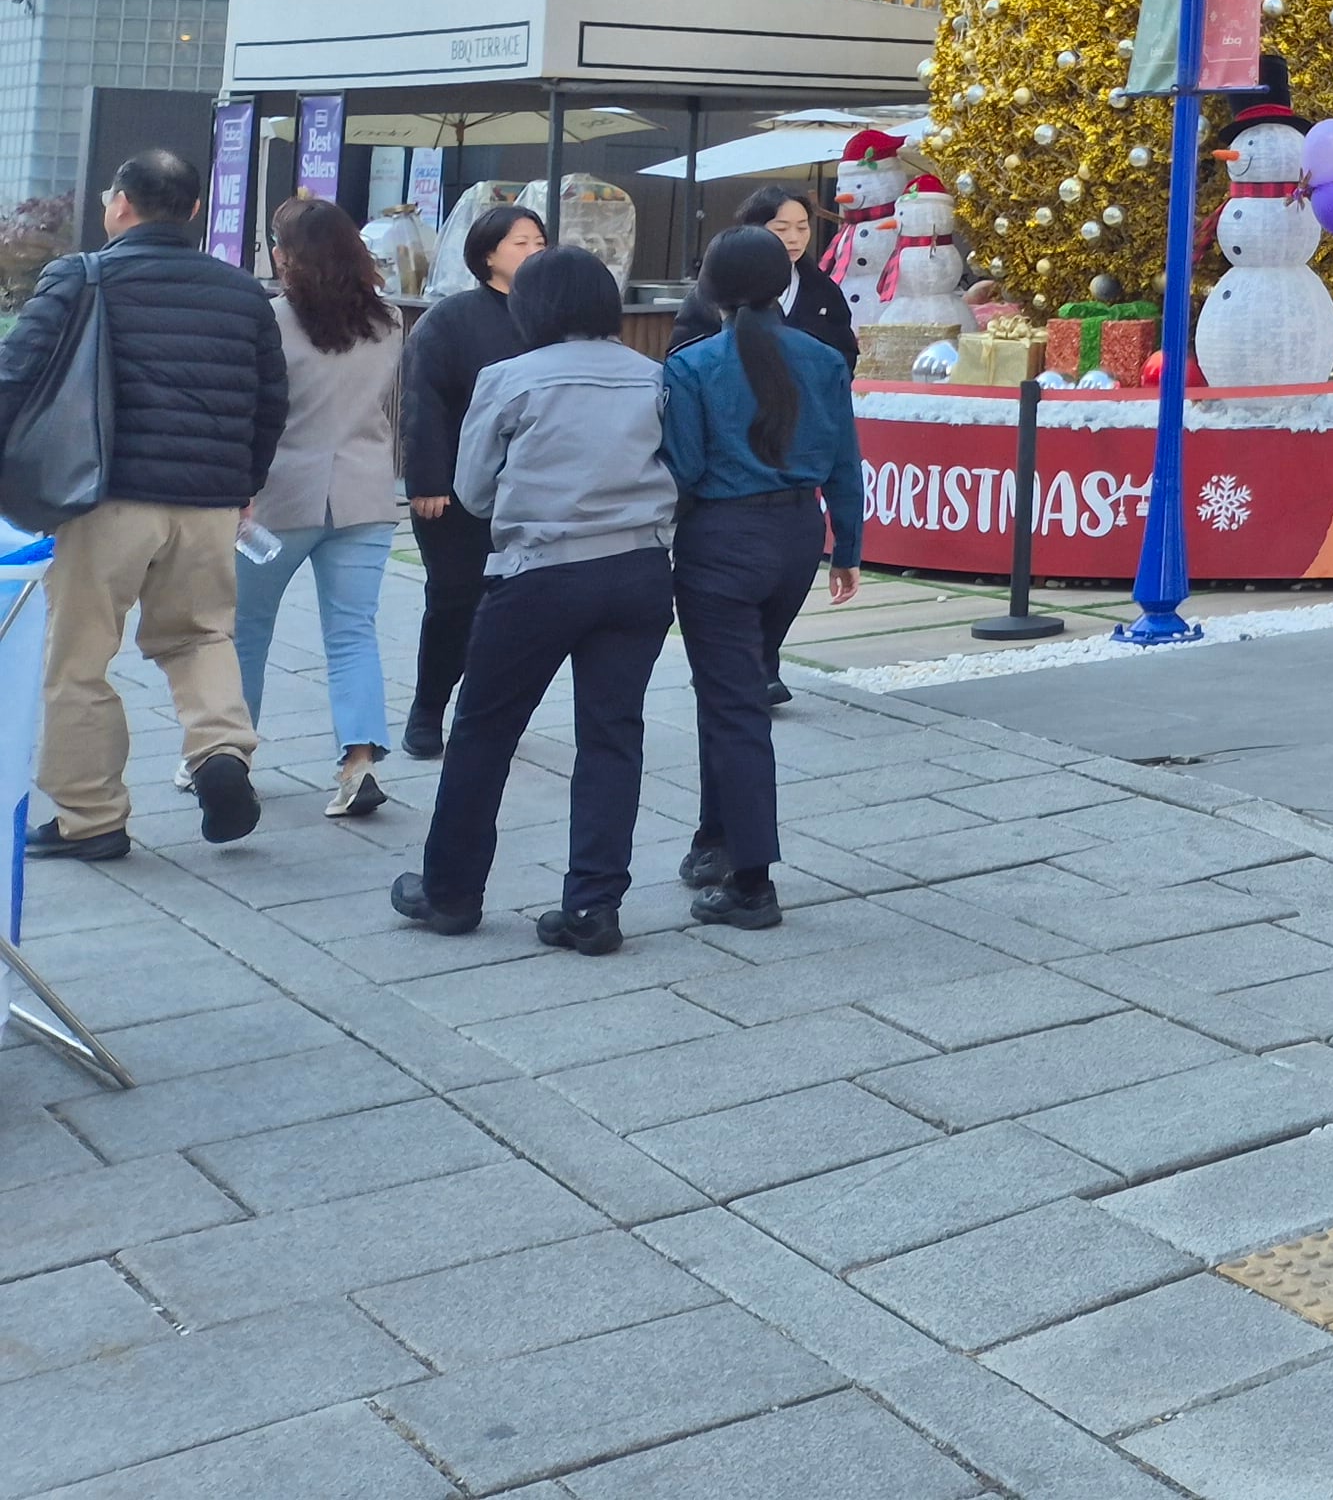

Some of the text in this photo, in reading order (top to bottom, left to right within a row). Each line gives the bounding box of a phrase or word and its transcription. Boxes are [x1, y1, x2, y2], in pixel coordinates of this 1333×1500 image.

[451, 34, 521, 63] BBQ TERRACE
[308, 128, 332, 152] Best
[301, 154, 337, 178] Sellers
[219, 174, 241, 206] WE
[213, 208, 241, 234] ARE
